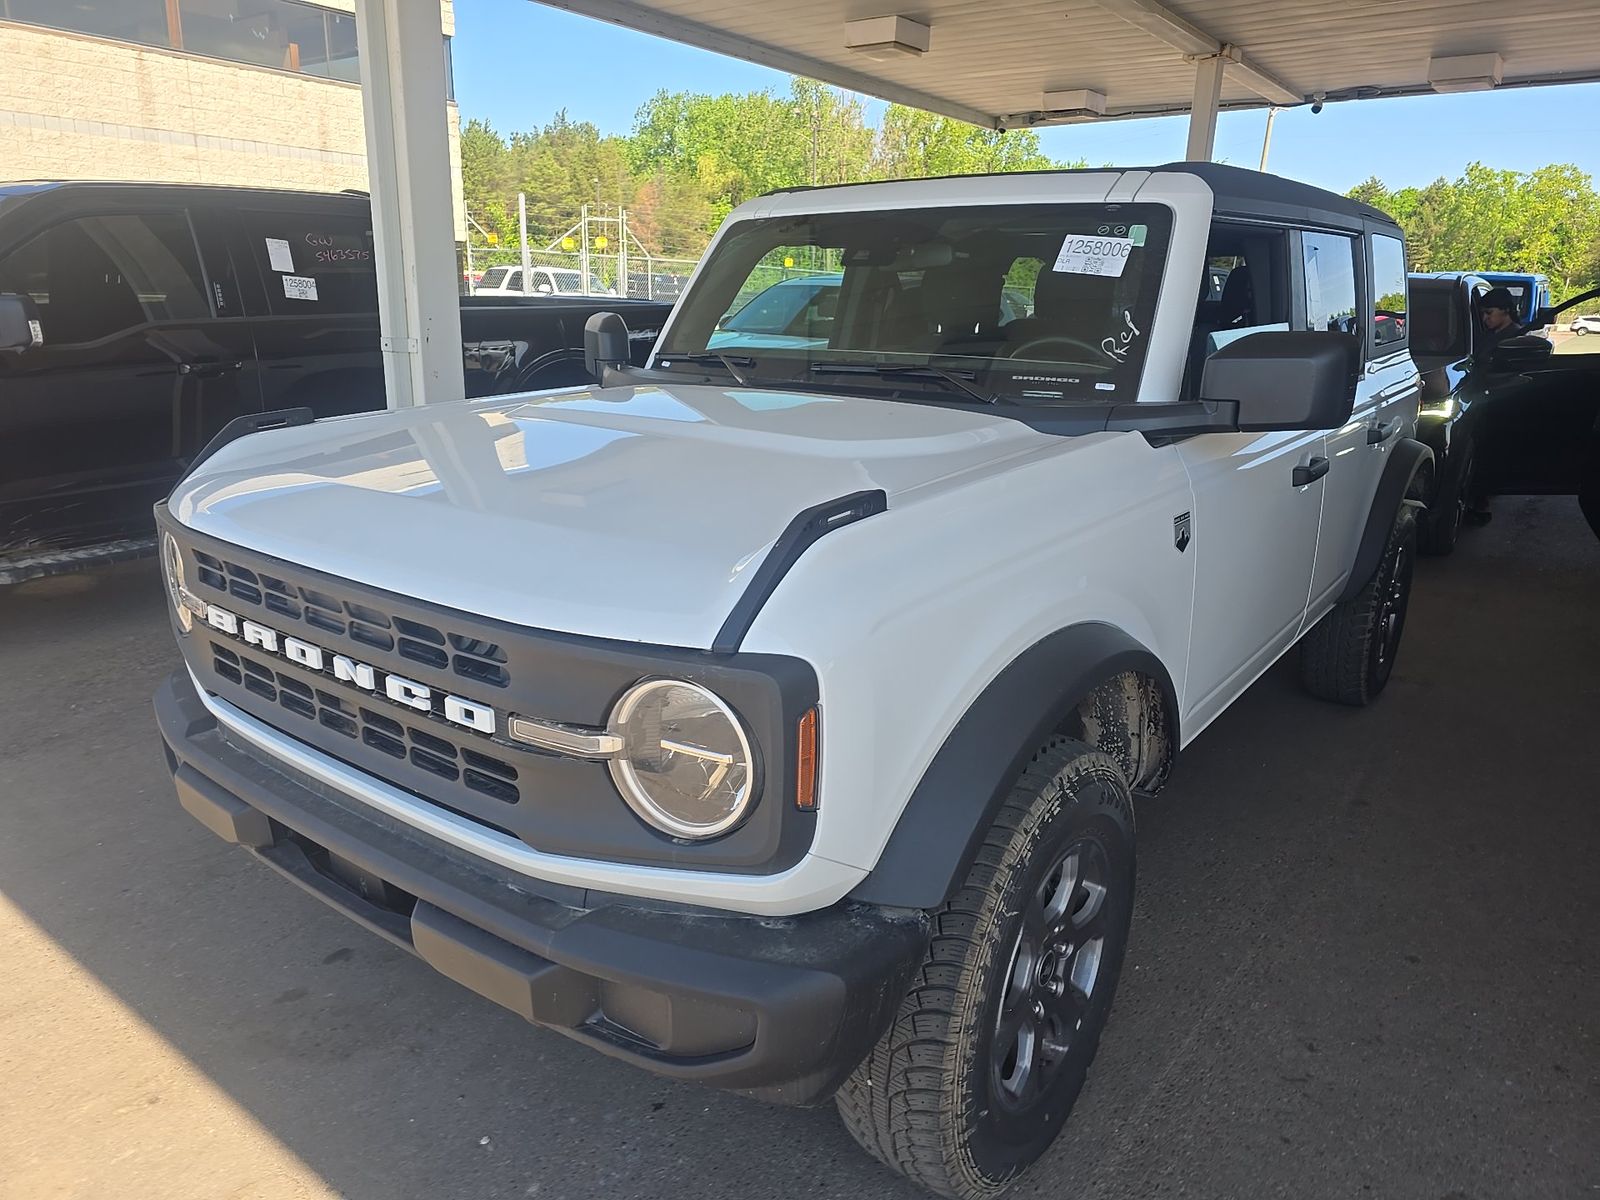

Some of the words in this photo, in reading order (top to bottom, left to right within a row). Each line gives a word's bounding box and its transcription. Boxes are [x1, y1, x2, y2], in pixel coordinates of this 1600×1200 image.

[305, 232, 333, 247] GW
[1066, 239, 1133, 258] 1258006
[207, 604, 496, 734] BRONCO
